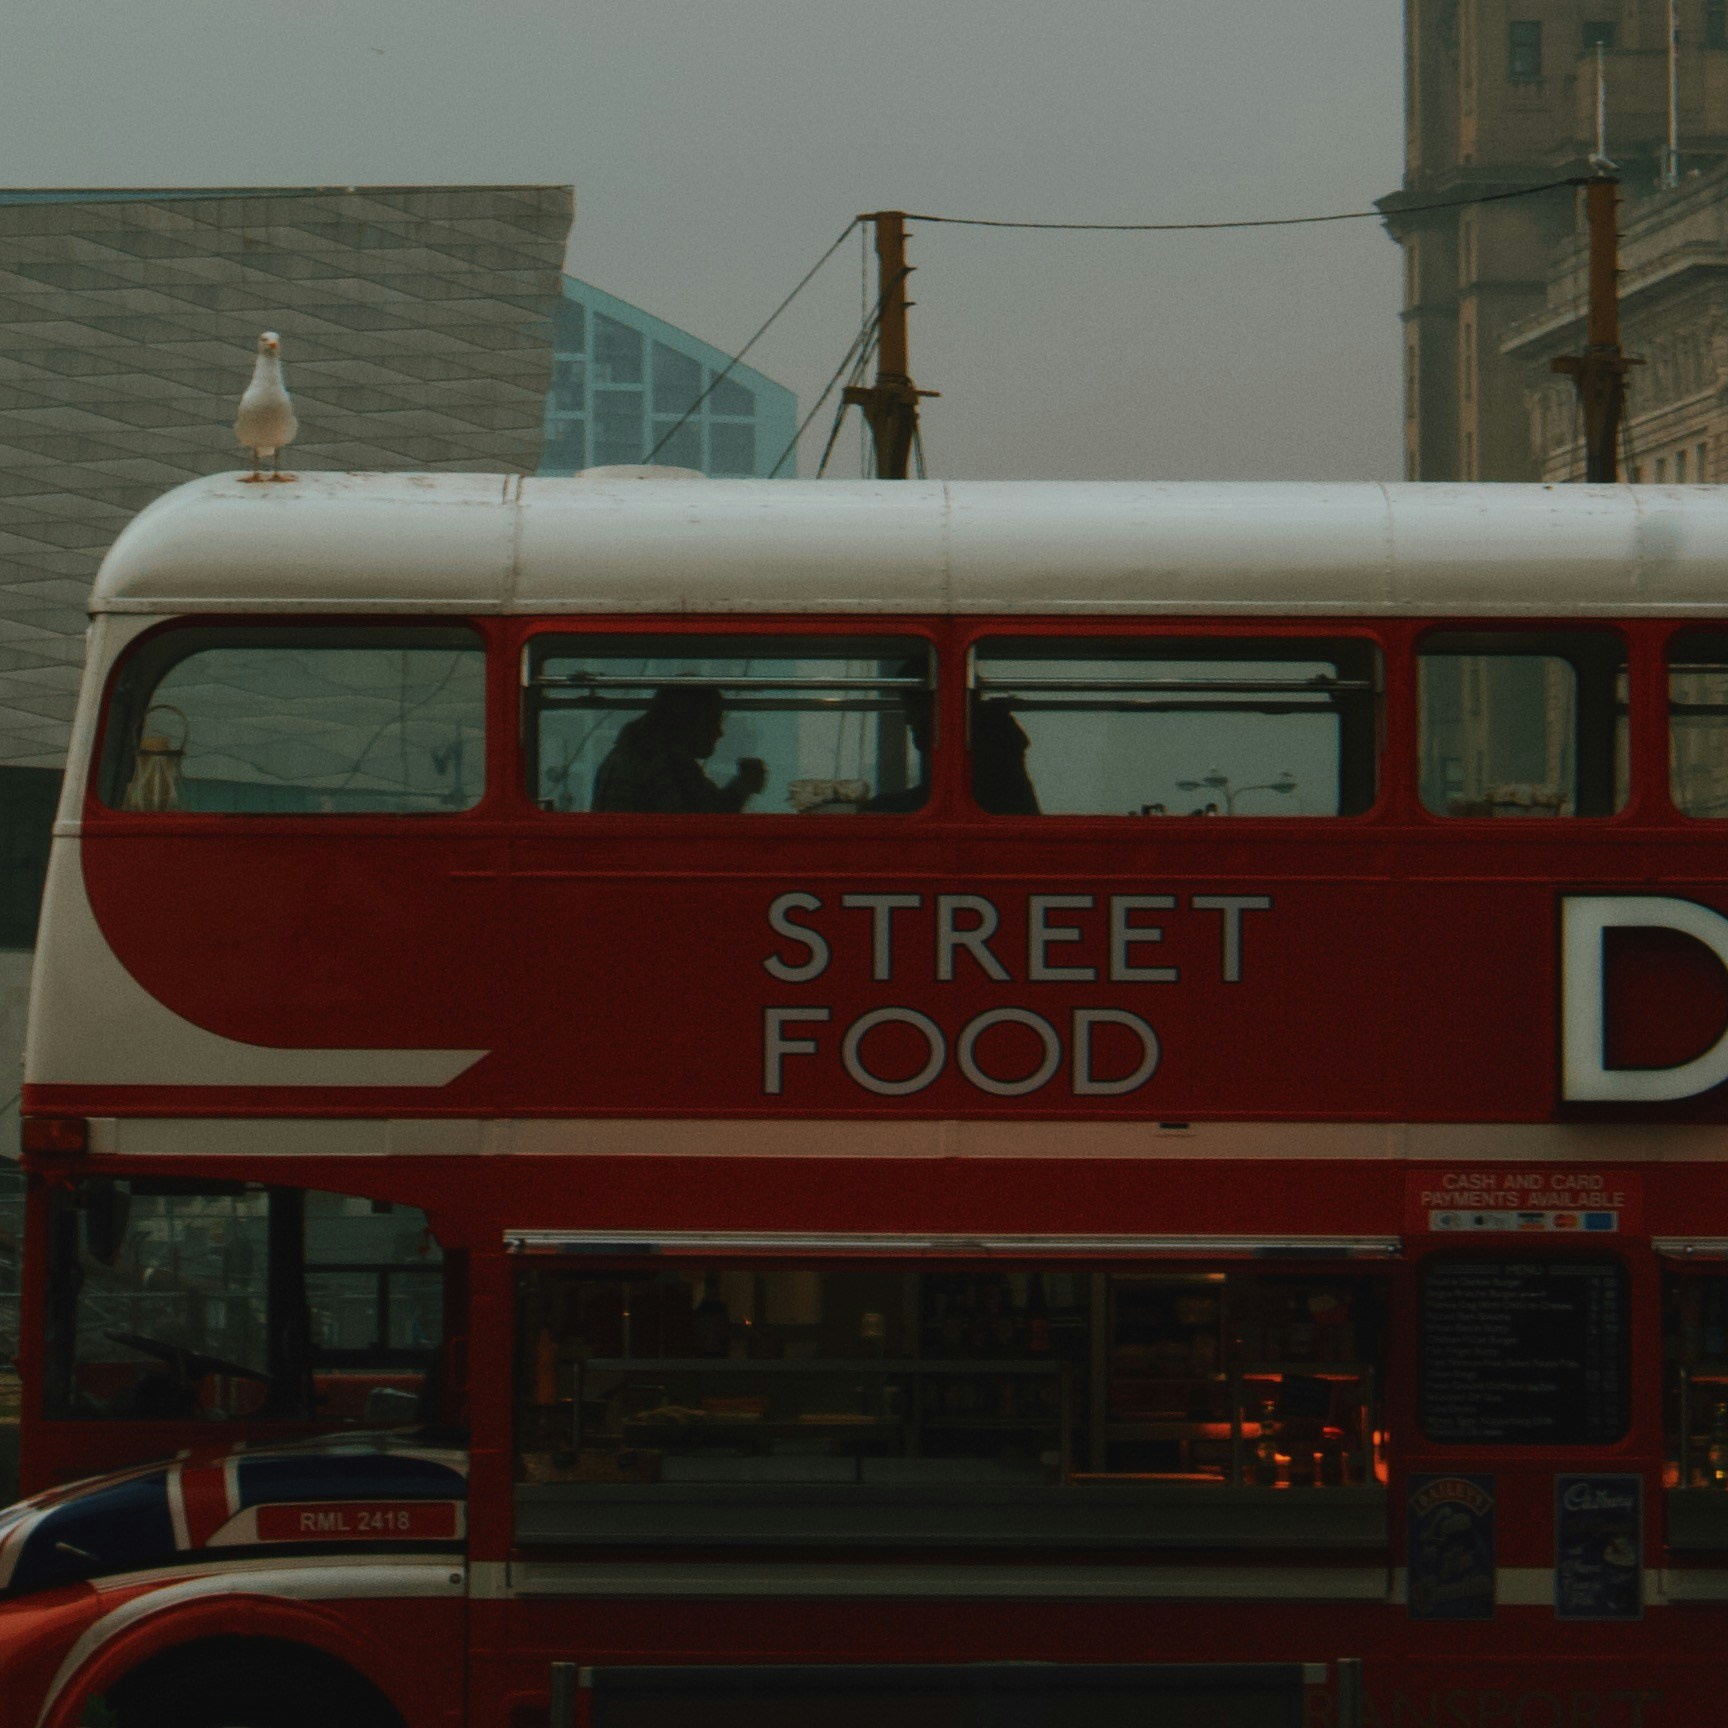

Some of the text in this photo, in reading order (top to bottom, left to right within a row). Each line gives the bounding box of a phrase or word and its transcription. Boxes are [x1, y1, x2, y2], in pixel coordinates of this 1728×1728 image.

[761, 891, 1272, 982] STREET
[761, 1006, 1161, 1096] FOOD
[1442, 1173, 1604, 1189] CASH AND CARD
[1421, 1191, 1626, 1208] PAYMENTS AVAILABLE
[299, 1511, 411, 1532] RML 2418
